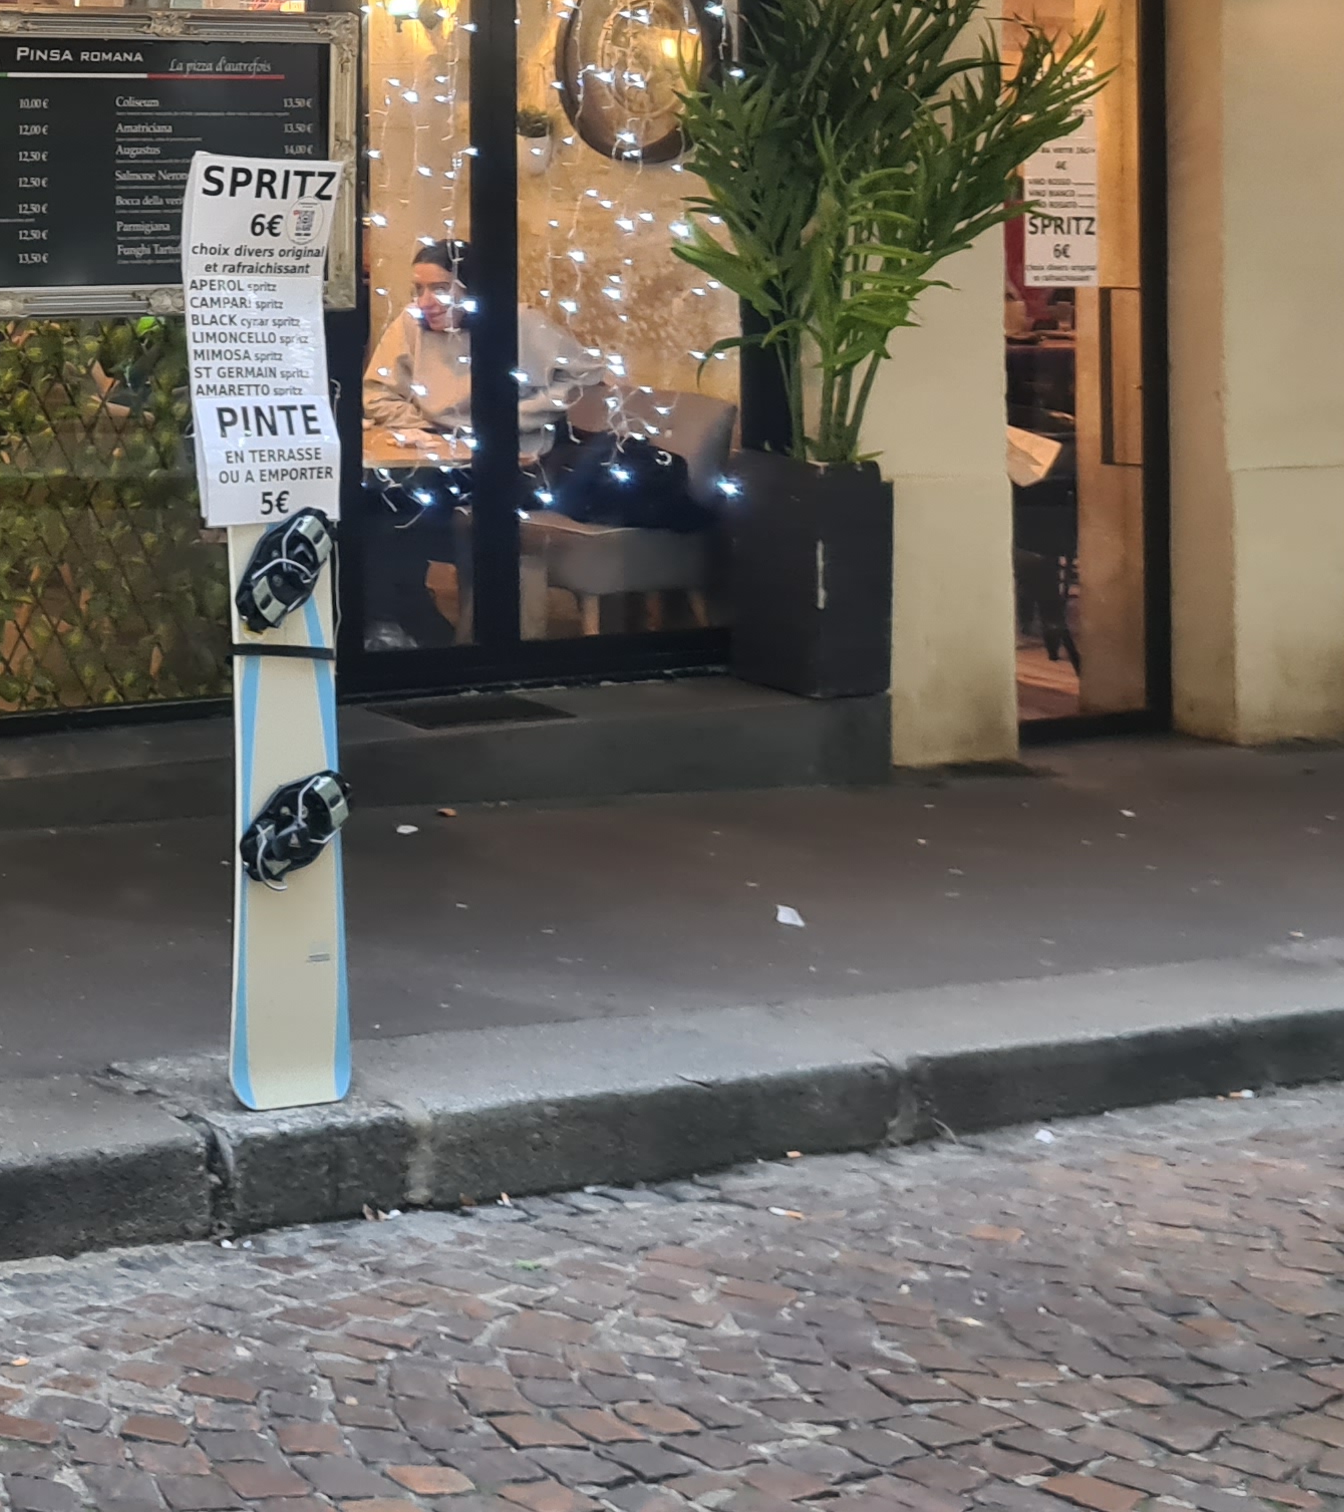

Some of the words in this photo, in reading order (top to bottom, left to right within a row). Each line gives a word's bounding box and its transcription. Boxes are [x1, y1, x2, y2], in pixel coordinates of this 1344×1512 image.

[16, 45, 74, 62] PINSA
[80, 50, 144, 63] ROMANA
[183, 61, 212, 76] pizza
[201, 165, 337, 201] SPRITZ
[250, 213, 284, 238] 6€
[1028, 217, 1096, 235] SPRITZ
[191, 243, 230, 258] choix
[233, 243, 274, 258] divers
[278, 244, 324, 262] original
[204, 263, 219, 273] et
[222, 261, 311, 275] rafraichissant
[190, 280, 244, 292] APEROL
[247, 281, 277, 294] spritz
[255, 298, 283, 312] spritz
[191, 314, 237, 326] BLACK
[272, 315, 300, 329] spritz
[192, 332, 277, 344] LIMONCELLO
[279, 333, 308, 347] sprtz
[194, 349, 251, 361] MIMOSA
[254, 349, 283, 364] spritz
[195, 367, 212, 378] ST
[217, 366, 277, 379] GERMAIN
[196, 384, 270, 396] AMARETTO
[225, 450, 246, 464] EN
[249, 448, 322, 463] TERRASSE
[219, 470, 241, 483] OU
[245, 470, 255, 483] A
[259, 467, 333, 482] EMPORTER
[260, 491, 289, 515] 5€
